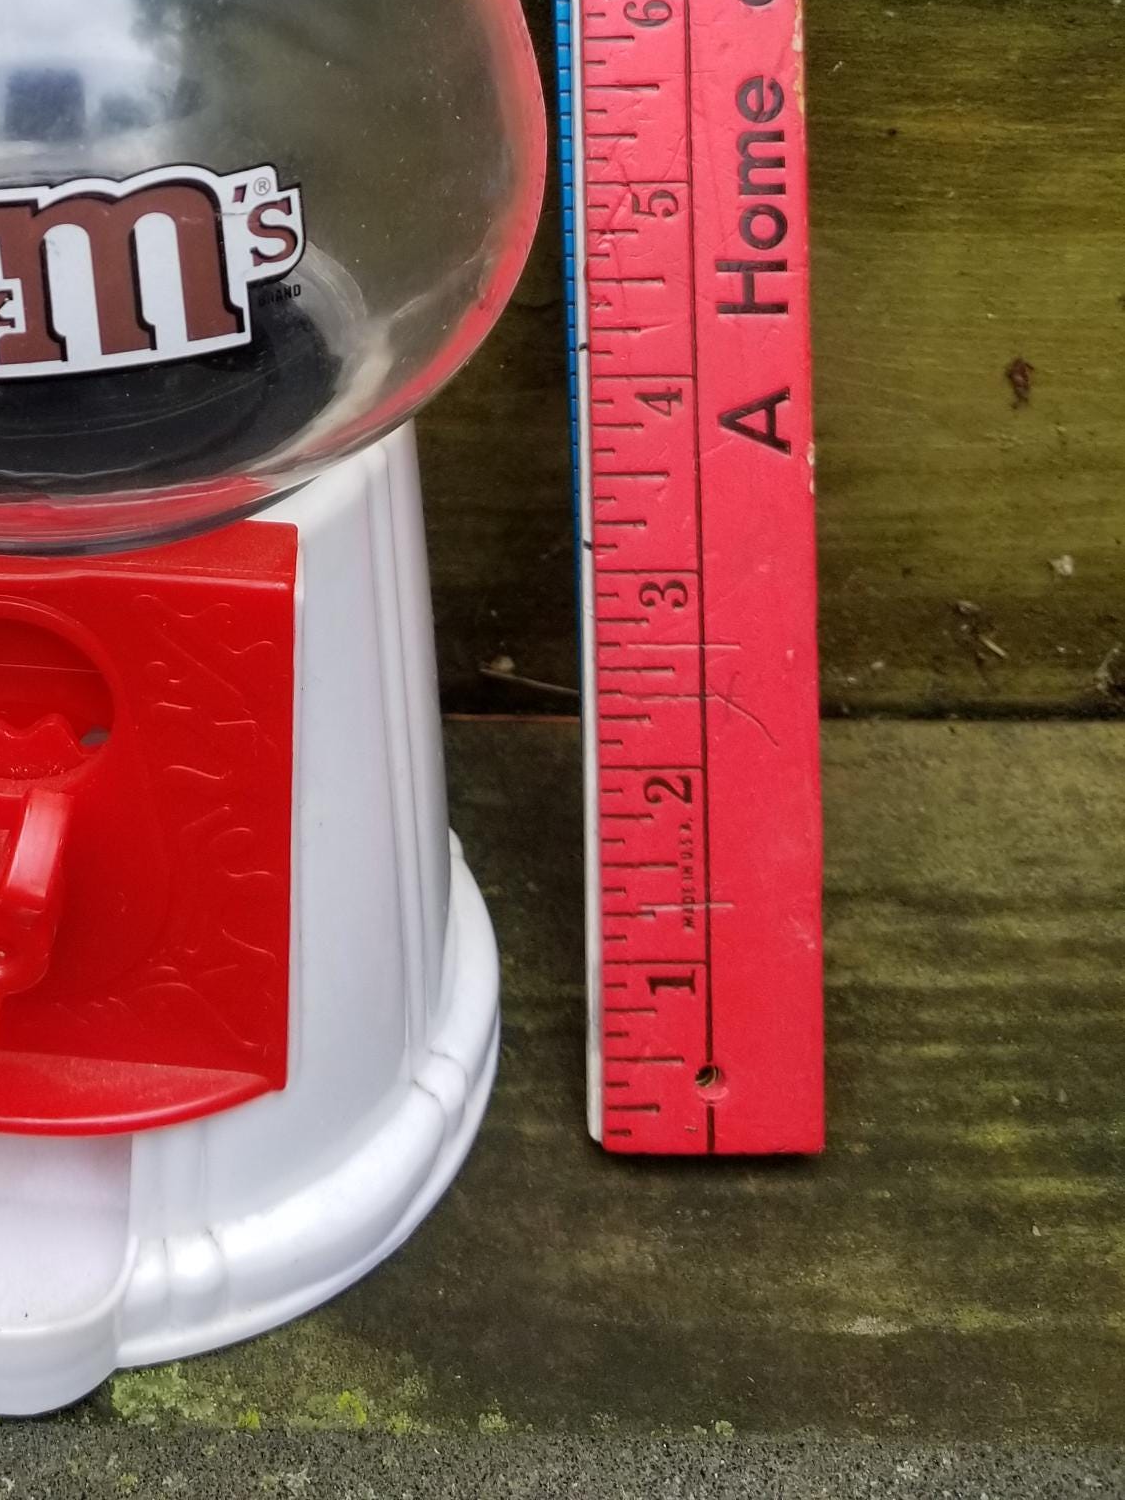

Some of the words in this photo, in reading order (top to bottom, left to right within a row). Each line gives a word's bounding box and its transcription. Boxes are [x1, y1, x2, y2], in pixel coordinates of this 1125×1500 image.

[624, 0, 673, 28] 6
[631, 189, 679, 218] 5
[715, 74, 789, 316] Home
[635, 386, 683, 418] 4
[718, 387, 792, 456] A
[639, 579, 689, 609] 3
[644, 774, 693, 805] 2
[645, 969, 696, 997] 1
